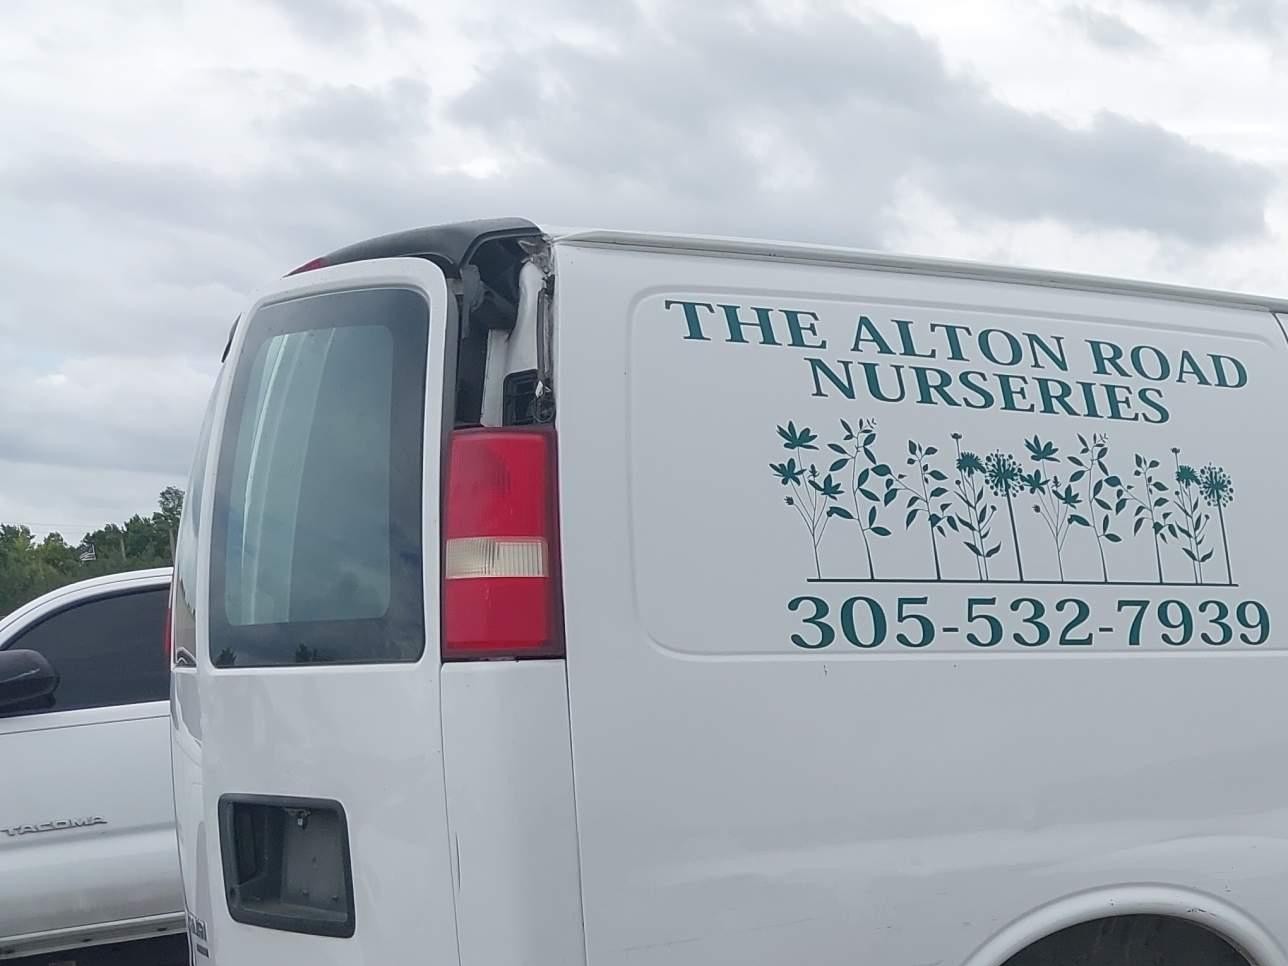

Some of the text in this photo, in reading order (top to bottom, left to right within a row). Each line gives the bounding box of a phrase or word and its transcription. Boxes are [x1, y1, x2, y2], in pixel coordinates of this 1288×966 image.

[665, 299, 1248, 389] THE ALTON ROAD
[803, 357, 1171, 424] NURSERIES
[787, 596, 1270, 650] 305-532-7939
[1, 816, 107, 836] TACOMA
